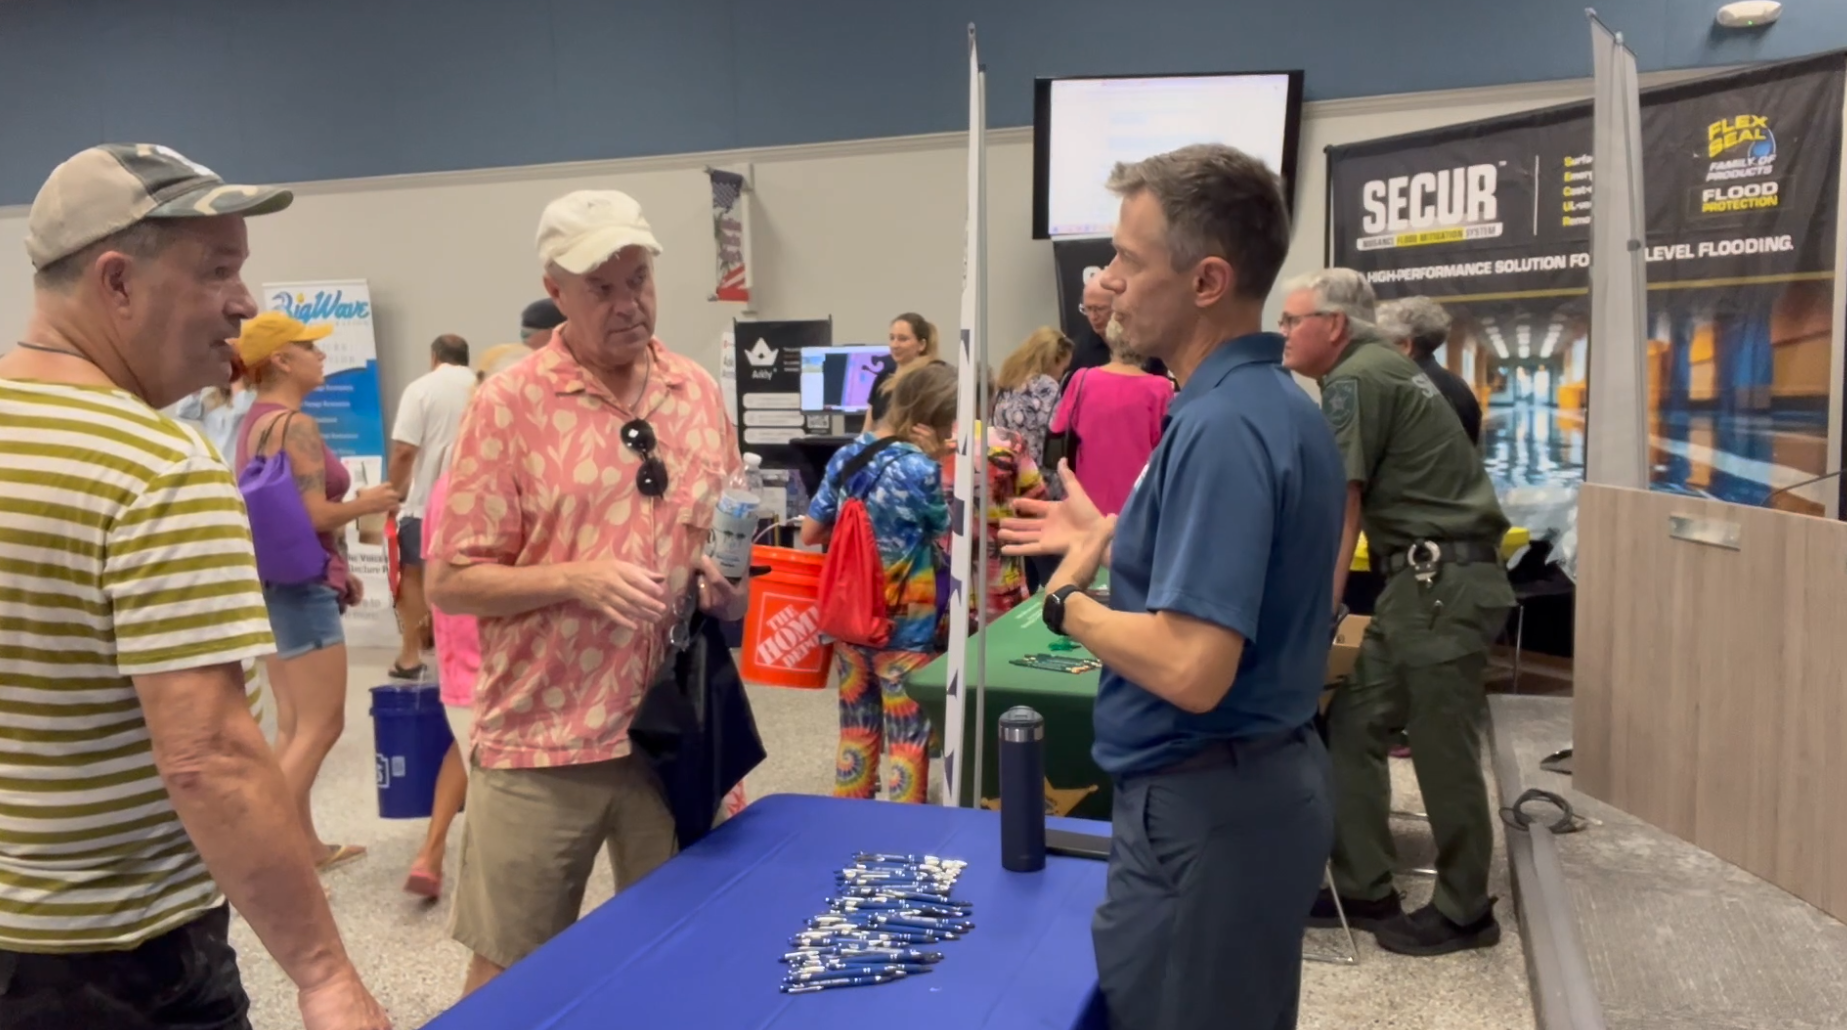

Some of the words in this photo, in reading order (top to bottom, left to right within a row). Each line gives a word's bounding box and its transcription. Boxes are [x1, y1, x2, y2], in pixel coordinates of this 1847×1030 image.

[1708, 114, 1769, 142] FLEX
[1708, 129, 1767, 159] SEAL
[1706, 165, 1773, 182] PRODUCTS
[1710, 157, 1756, 172] FAMILY
[1758, 154, 1778, 167] OF
[1362, 163, 1498, 235] SECUR
[1702, 181, 1779, 203] FLOOD
[1702, 195, 1779, 213] PROTECTION
[1466, 225, 1497, 237] SYSTEM
[1367, 261, 1493, 284] HIGH-PERFORMANCE
[1495, 254, 1567, 274] SOLUTION
[766, 603, 800, 632] THE
